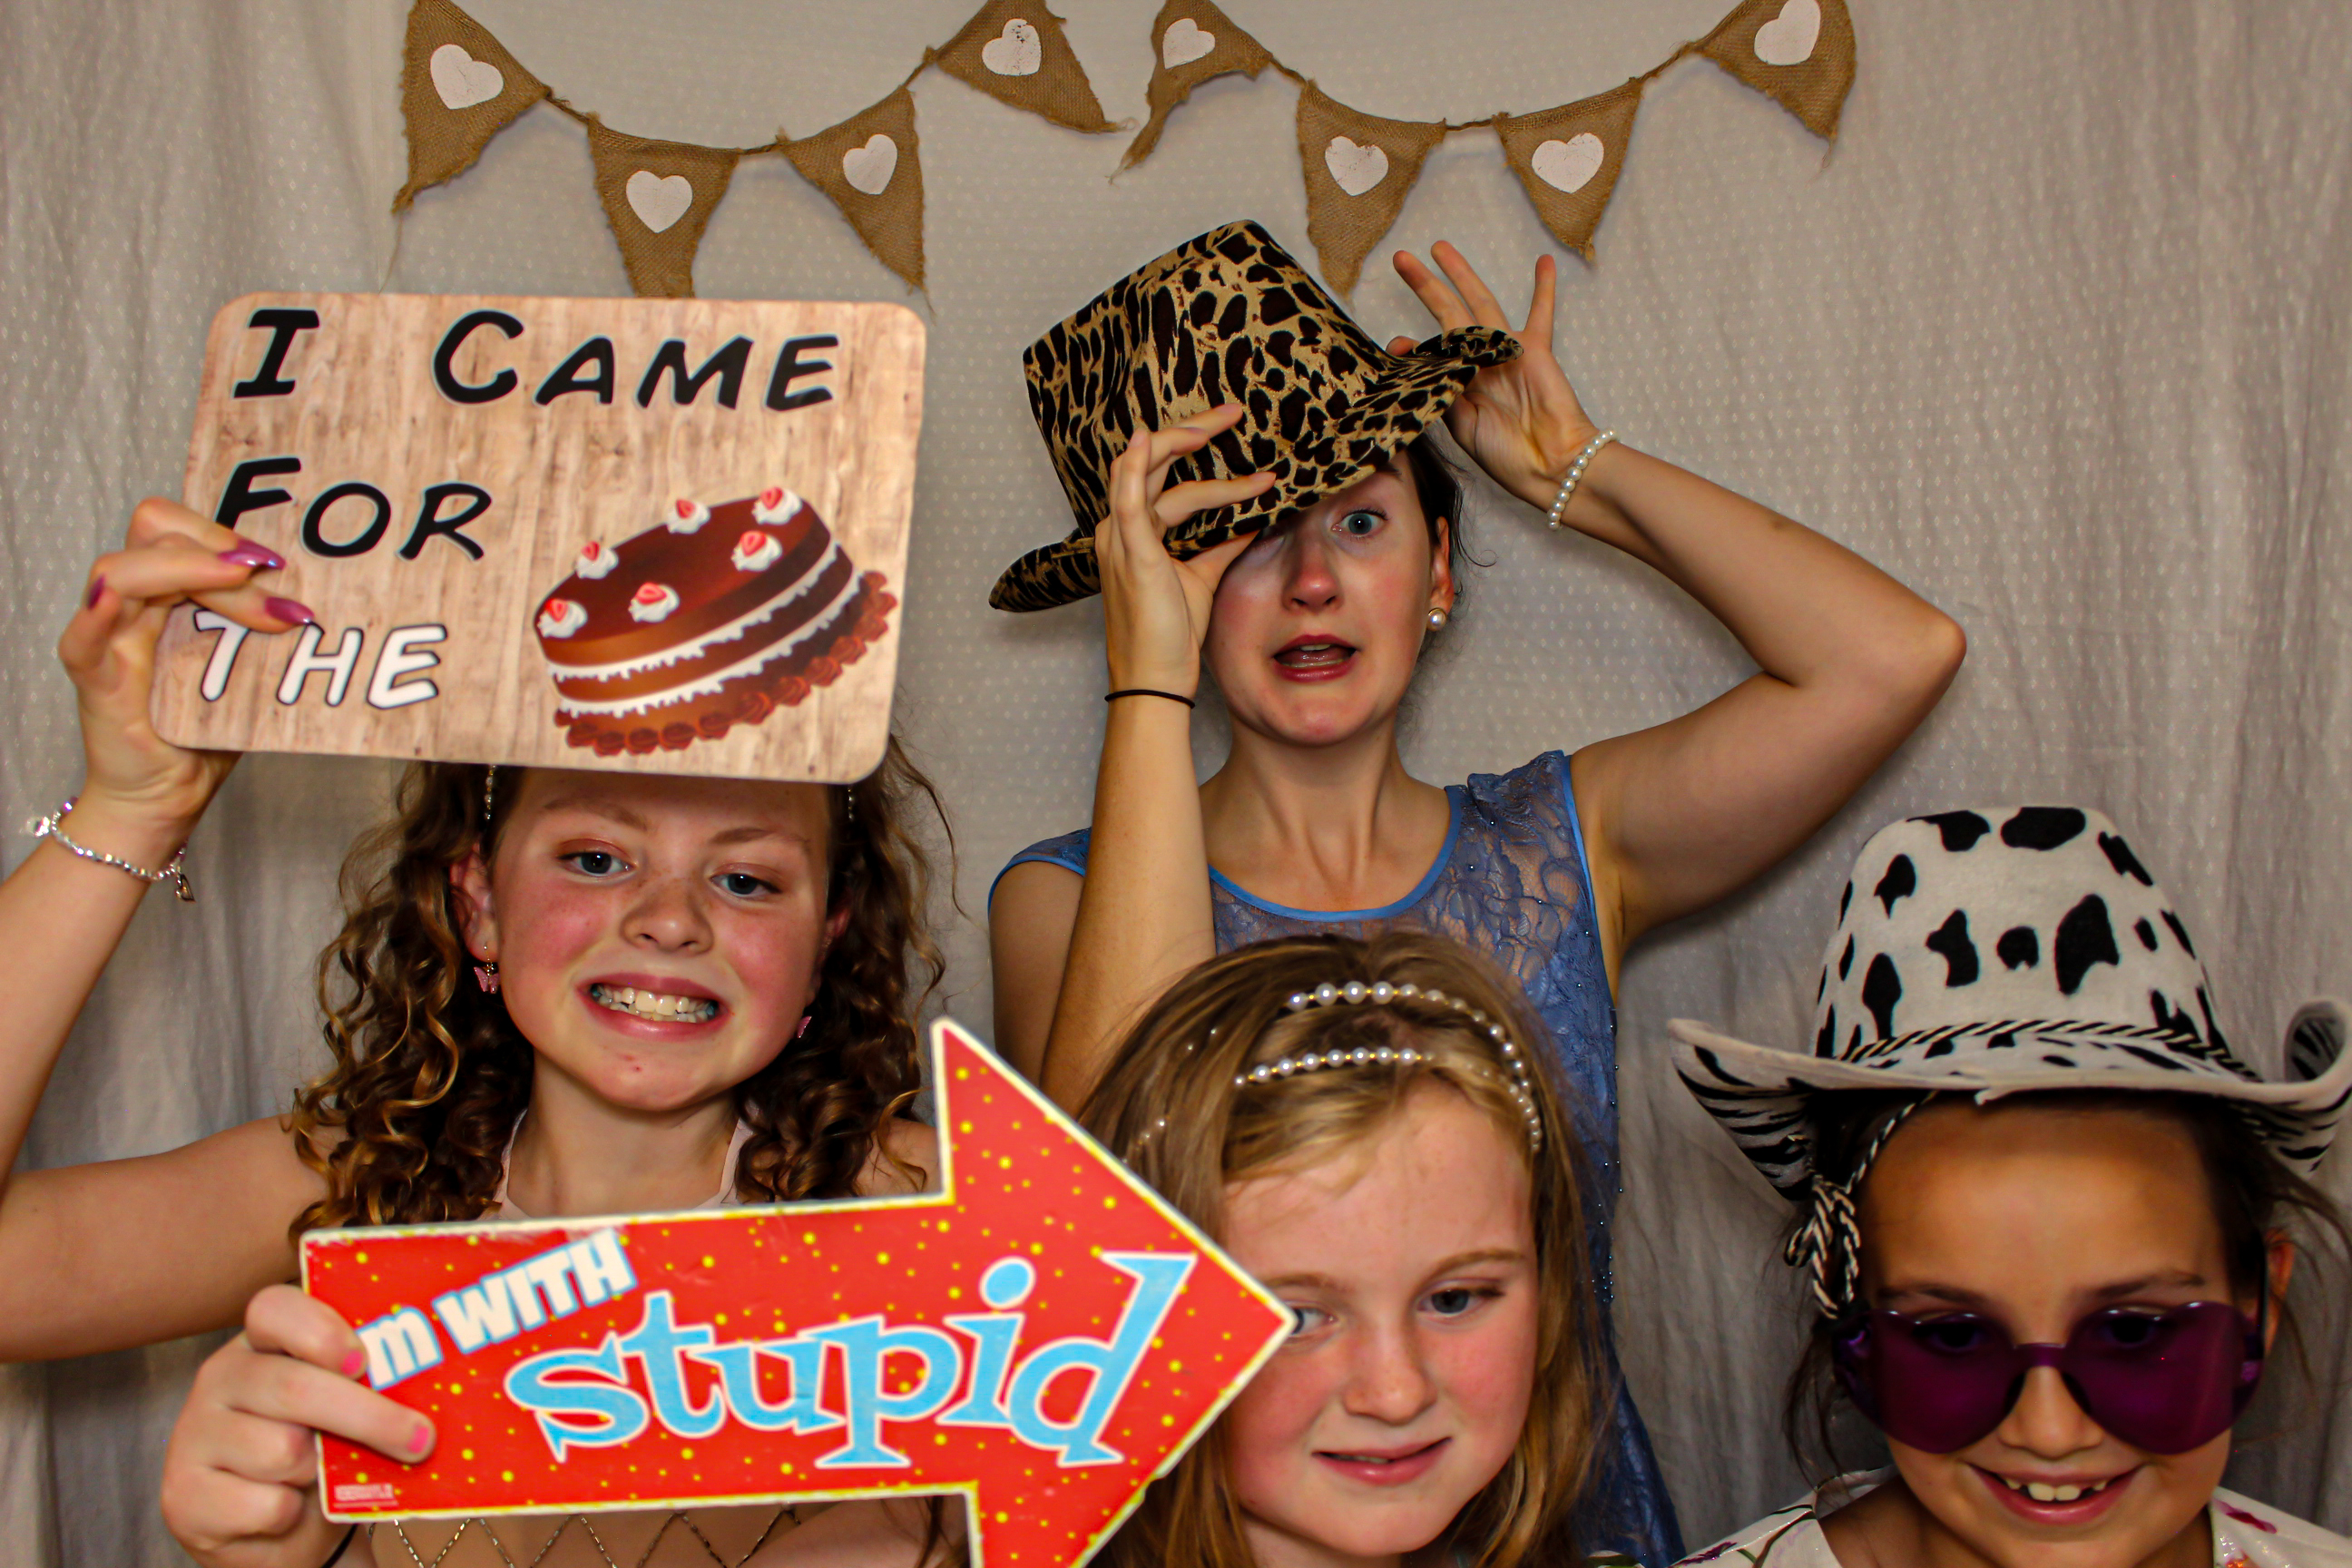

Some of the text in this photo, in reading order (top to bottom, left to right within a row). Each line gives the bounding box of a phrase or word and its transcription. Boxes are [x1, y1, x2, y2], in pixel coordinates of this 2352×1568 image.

[231, 309, 839, 411] I CAME
[214, 456, 492, 560] FOR
[192, 606, 447, 710] THE
[354, 1225, 638, 1391] m WITH
[504, 1250, 1199, 1467] stupid
